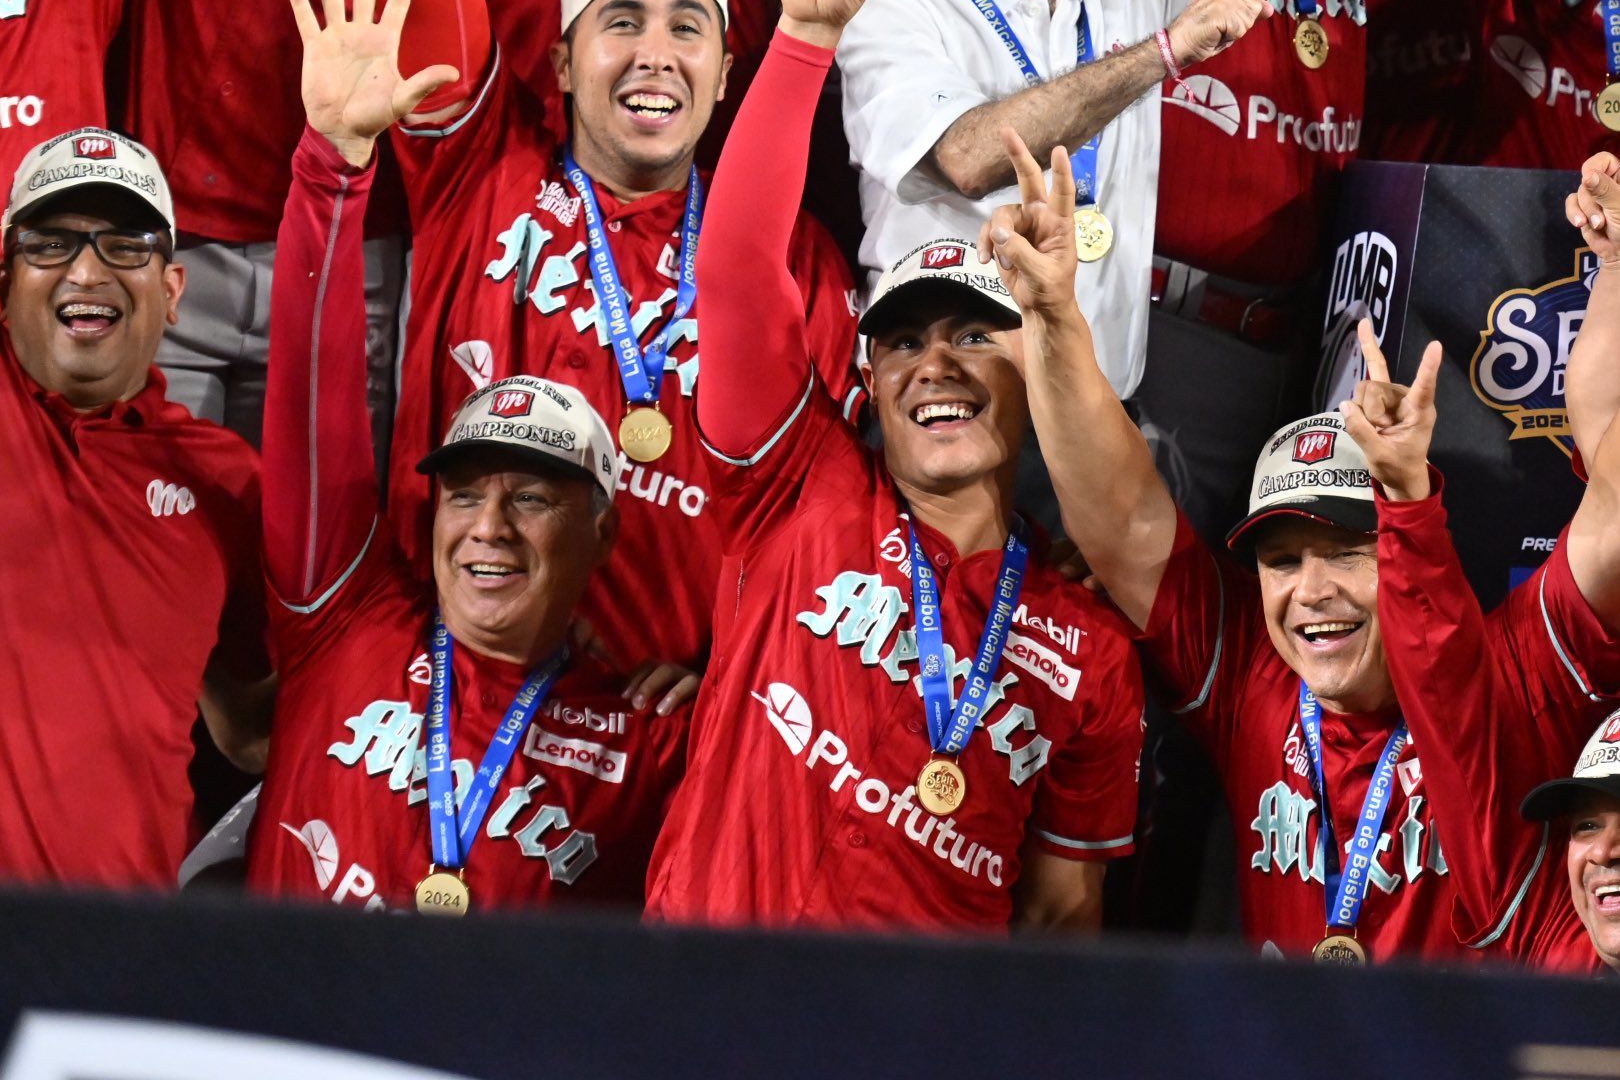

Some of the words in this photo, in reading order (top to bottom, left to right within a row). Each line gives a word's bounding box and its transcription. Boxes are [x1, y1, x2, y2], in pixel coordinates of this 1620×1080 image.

[28, 163, 157, 197] CAMPEONES
[588, 227, 602, 249] de
[592, 252, 628, 336] Mexicana
[1325, 231, 1397, 348] LMB
[624, 338, 640, 378] Liga
[453, 421, 577, 452] CAMPEONES
[1308, 417, 1342, 429] DEL
[1258, 469, 1373, 500] CAMPEONE
[917, 566, 939, 633] Beisbol
[1000, 566, 1021, 600] Liga
[434, 625, 447, 647] de
[976, 602, 1013, 676] Mexicana
[1012, 603, 1080, 655] Mobil
[1003, 641, 1070, 688] Lenovo
[429, 647, 447, 730] Mexicana
[967, 675, 989, 699] de
[497, 708, 525, 746] Liga
[544, 698, 625, 735] Mobil
[945, 700, 979, 755] Beisb
[429, 731, 444, 772] Liga
[533, 733, 617, 772] Lenovo
[1364, 734, 1406, 820] Mexicana
[805, 728, 1003, 888] Profuturo
[1357, 825, 1374, 850] de
[424, 890, 461, 908] 2024
[1338, 854, 1368, 926] Beisbol
